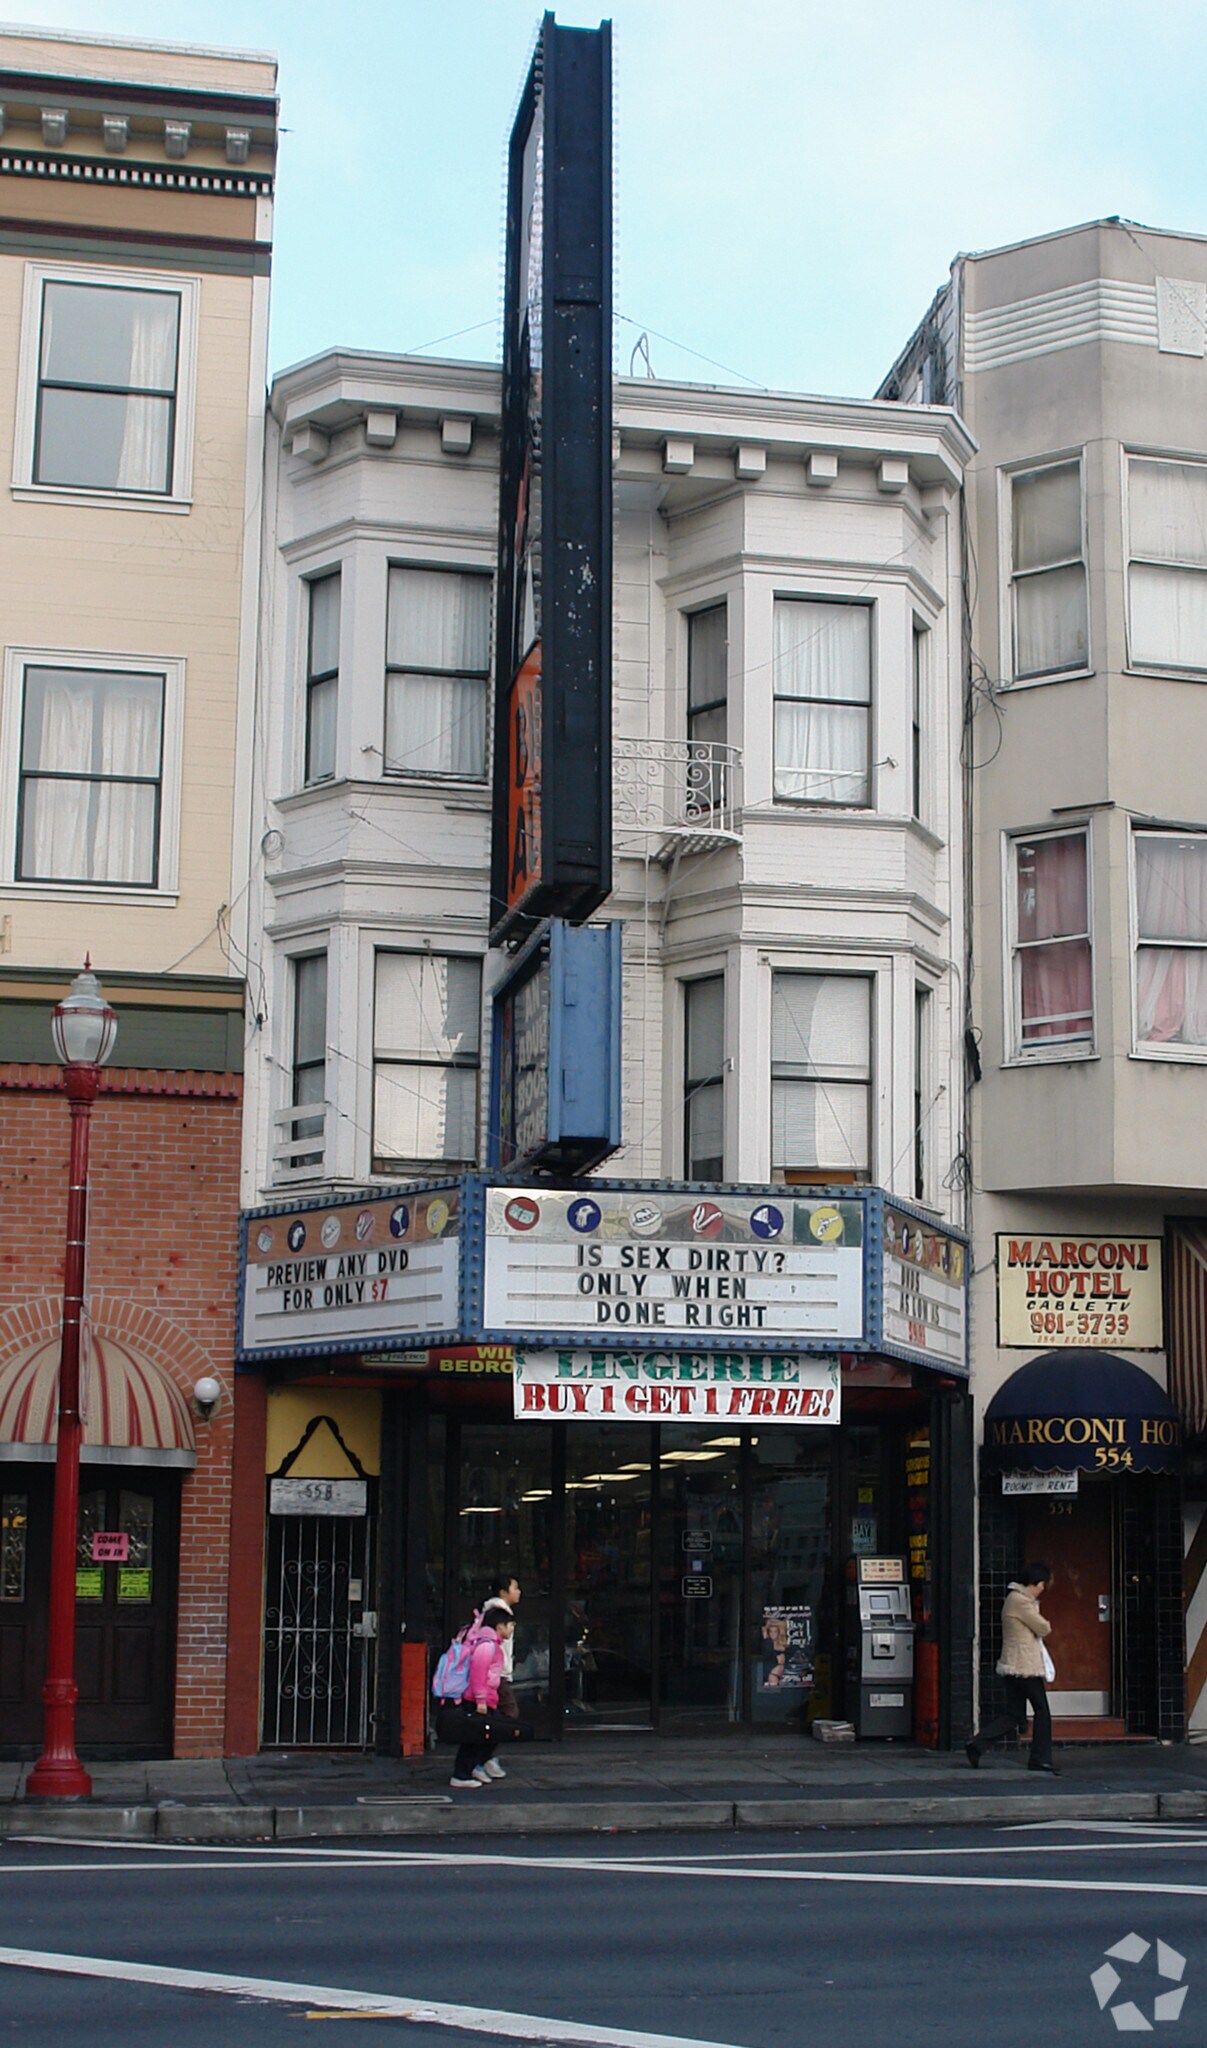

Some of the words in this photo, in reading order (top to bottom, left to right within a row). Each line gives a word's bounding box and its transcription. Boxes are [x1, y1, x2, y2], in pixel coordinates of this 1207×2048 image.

[266, 1257, 328, 1288] PREVIEW
[336, 1253, 368, 1279] ANY
[378, 1248, 410, 1273] DVD
[577, 1244, 602, 1267] IS
[620, 1245, 670, 1270] SEX
[689, 1247, 786, 1273] DIRTY?
[1007, 1240, 1149, 1270] MARCONI
[282, 1288, 313, 1312] FOR
[323, 1281, 365, 1307] ONLY
[371, 1278, 389, 1302] $7
[577, 1272, 648, 1297] ONLY
[671, 1275, 747, 1299] WHEN
[1026, 1270, 1131, 1299] HOTEL
[596, 1300, 666, 1325] DONE
[685, 1304, 767, 1328] RIGHT
[1027, 1300, 1097, 1312] CABLE
[1105, 1301, 1131, 1312] TV
[1030, 1311, 1130, 1336] 981-3733
[554, 1351, 800, 1384] LINGERIE
[521, 1383, 594, 1413] BUY
[599, 1385, 616, 1414] 1
[624, 1385, 697, 1415] GET
[703, 1387, 720, 1416] 1
[727, 1387, 835, 1418] FREE!
[992, 1416, 1127, 1446] MARCONI
[1094, 1446, 1133, 1468] 554
[1004, 1481, 1033, 1493] ROOMS
[1047, 1480, 1075, 1491] RENT
[1049, 1502, 1073, 1515] 554
[97, 1535, 123, 1545] COME
[98, 1548, 111, 1557] ON
[113, 1548, 124, 1557] IN
